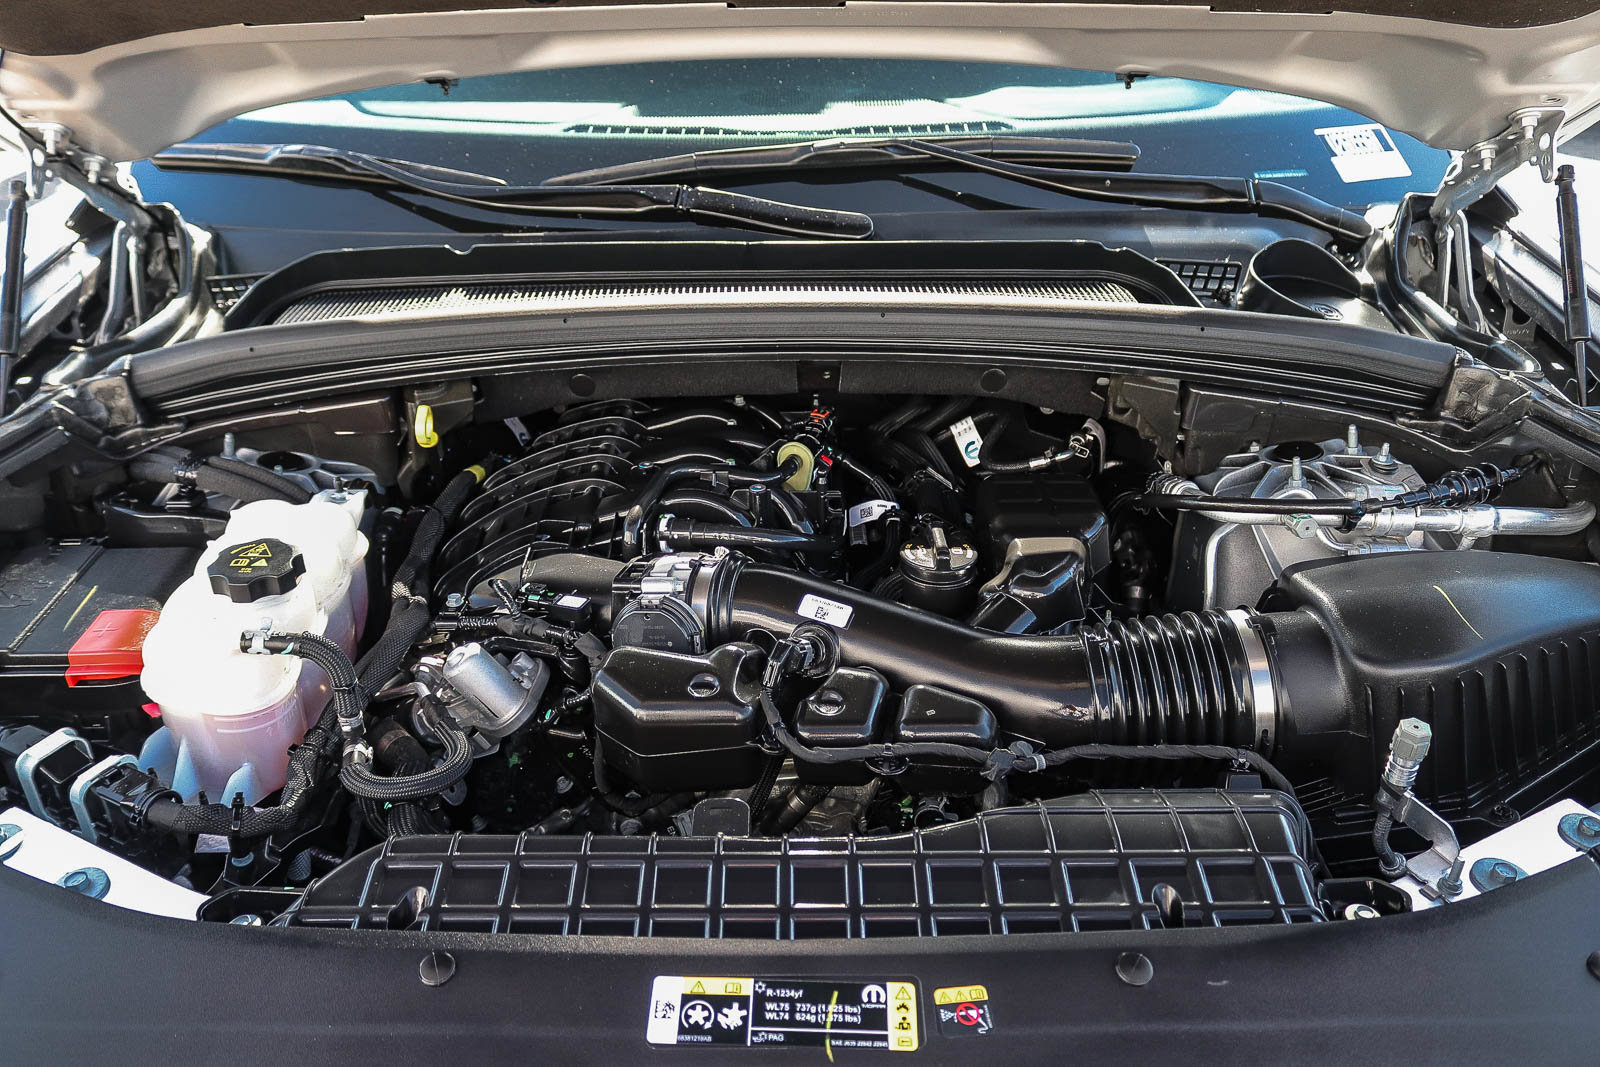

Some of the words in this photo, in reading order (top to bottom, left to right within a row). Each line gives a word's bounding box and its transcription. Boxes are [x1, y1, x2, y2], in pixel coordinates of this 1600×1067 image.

[766, 988, 803, 999] R-1234yf
[765, 1002, 790, 1011] WL75
[795, 1003, 817, 1014] 737g
[844, 1004, 861, 1015] lbs)
[764, 1012, 789, 1021] WL74
[795, 1013, 817, 1023] 624g
[844, 1014, 861, 1025] lbs)
